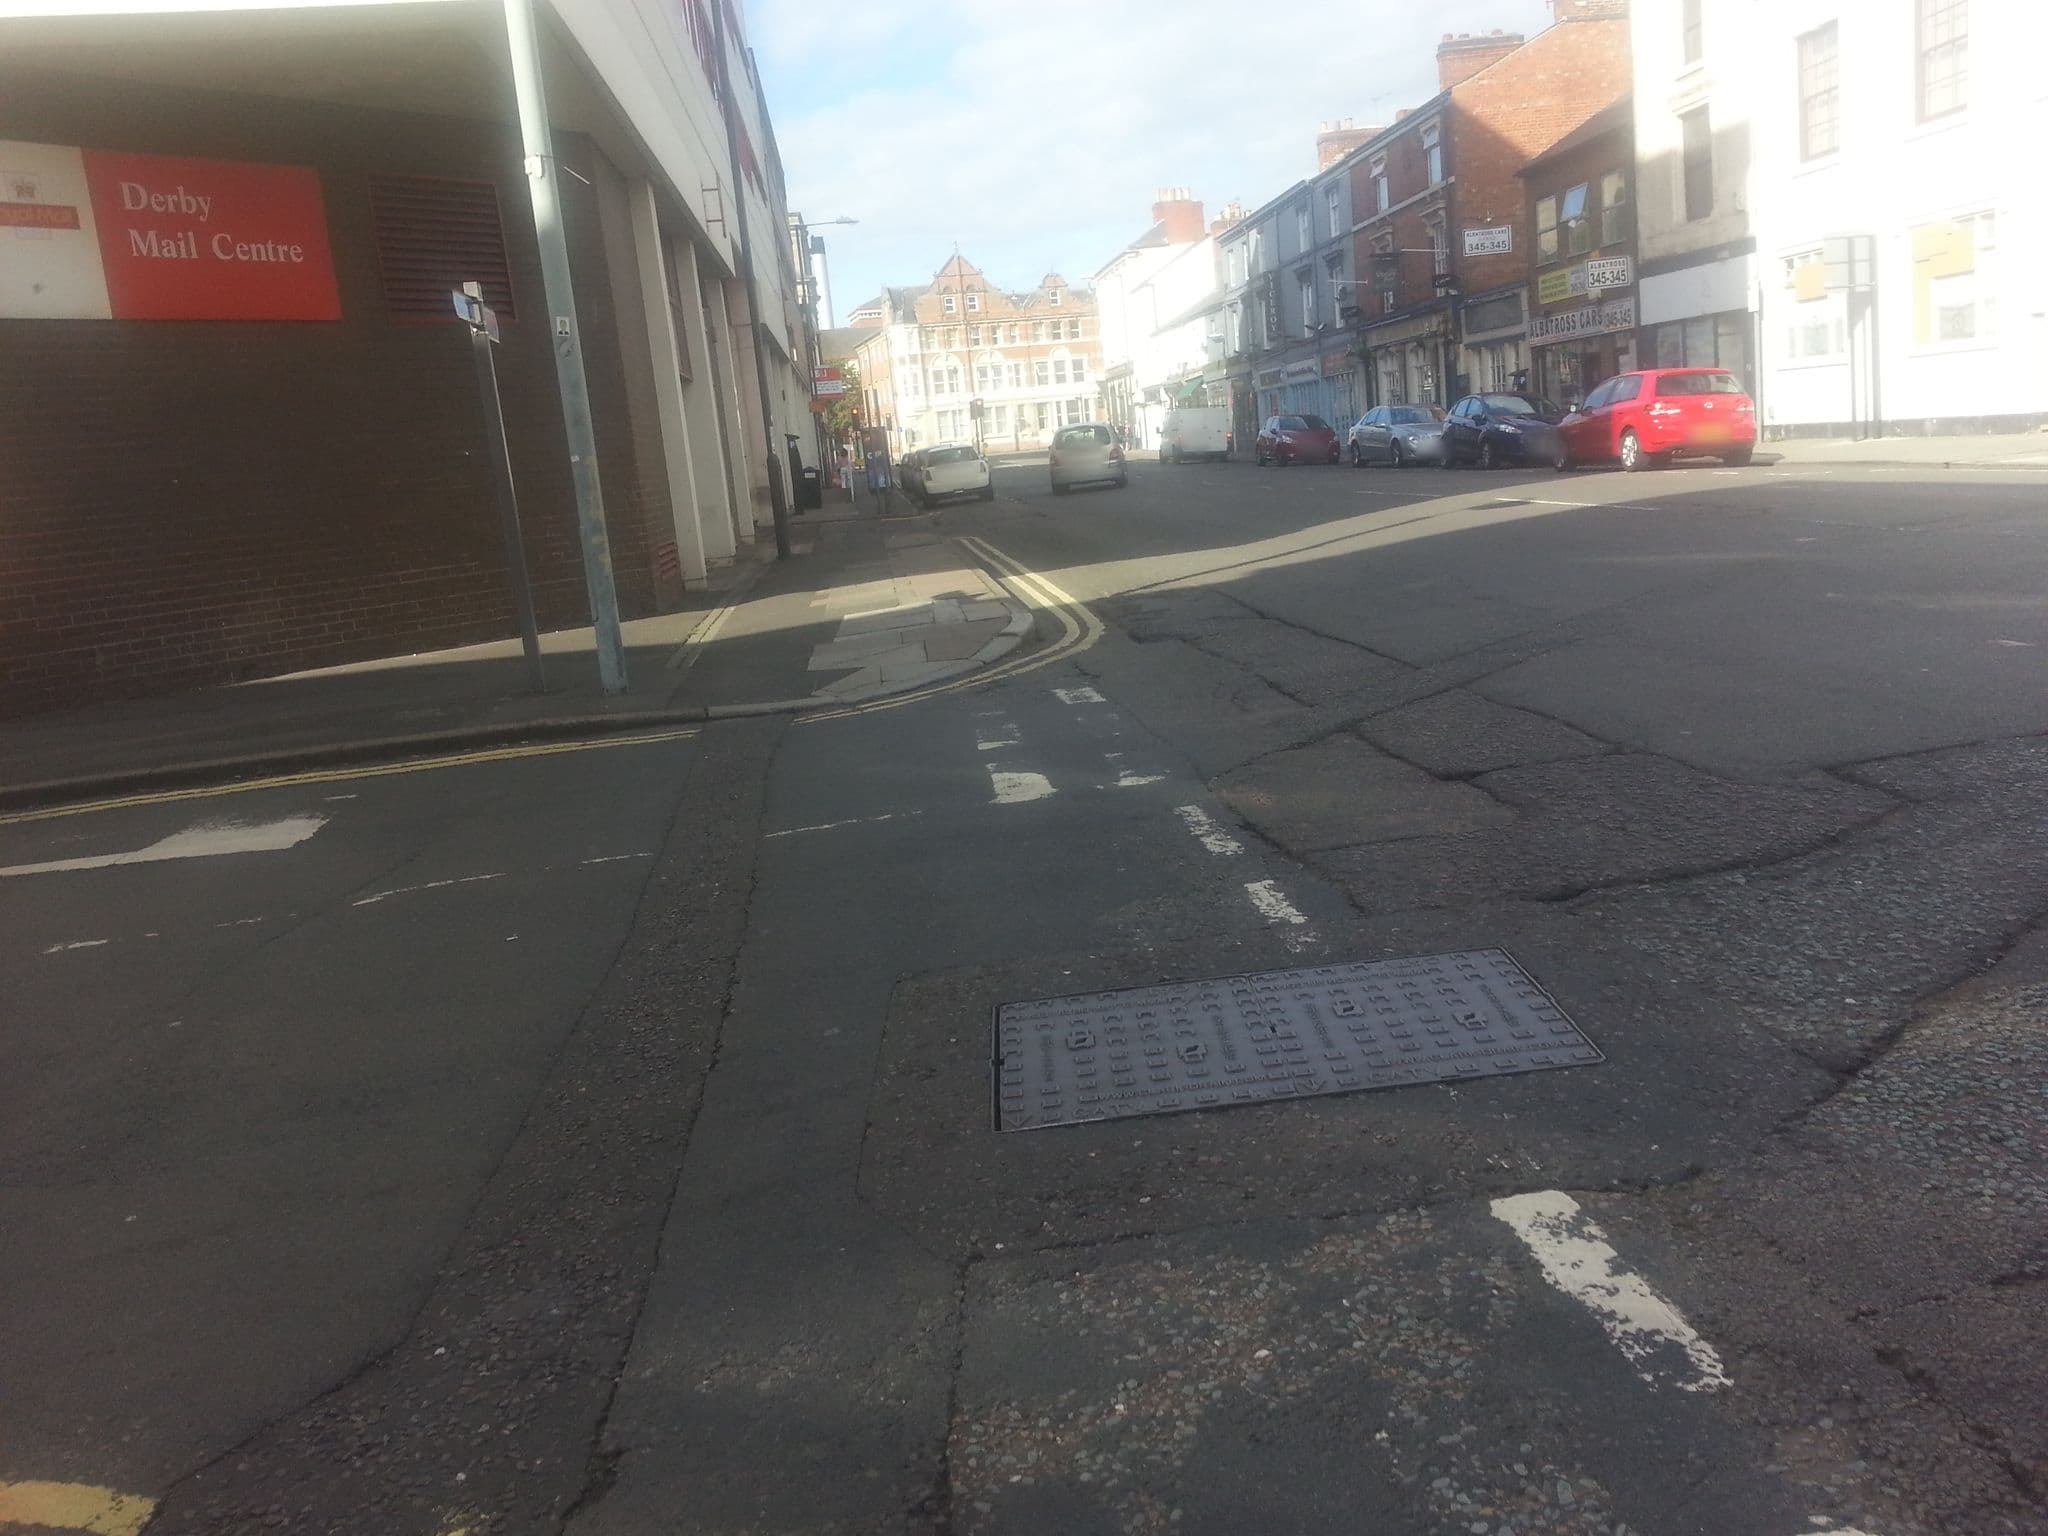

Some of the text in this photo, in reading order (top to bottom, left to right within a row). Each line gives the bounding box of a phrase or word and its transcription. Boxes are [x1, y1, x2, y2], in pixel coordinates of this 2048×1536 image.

[120, 182, 212, 222] Derby
[128, 228, 304, 263] Mail Centre
[1468, 240, 1507, 251] 345-345
[1590, 259, 1626, 269] ALBATROSS
[1590, 270, 1626, 285] 345-345
[1529, 313, 1577, 338] ALBATROSS
[1580, 309, 1602, 329] CARS
